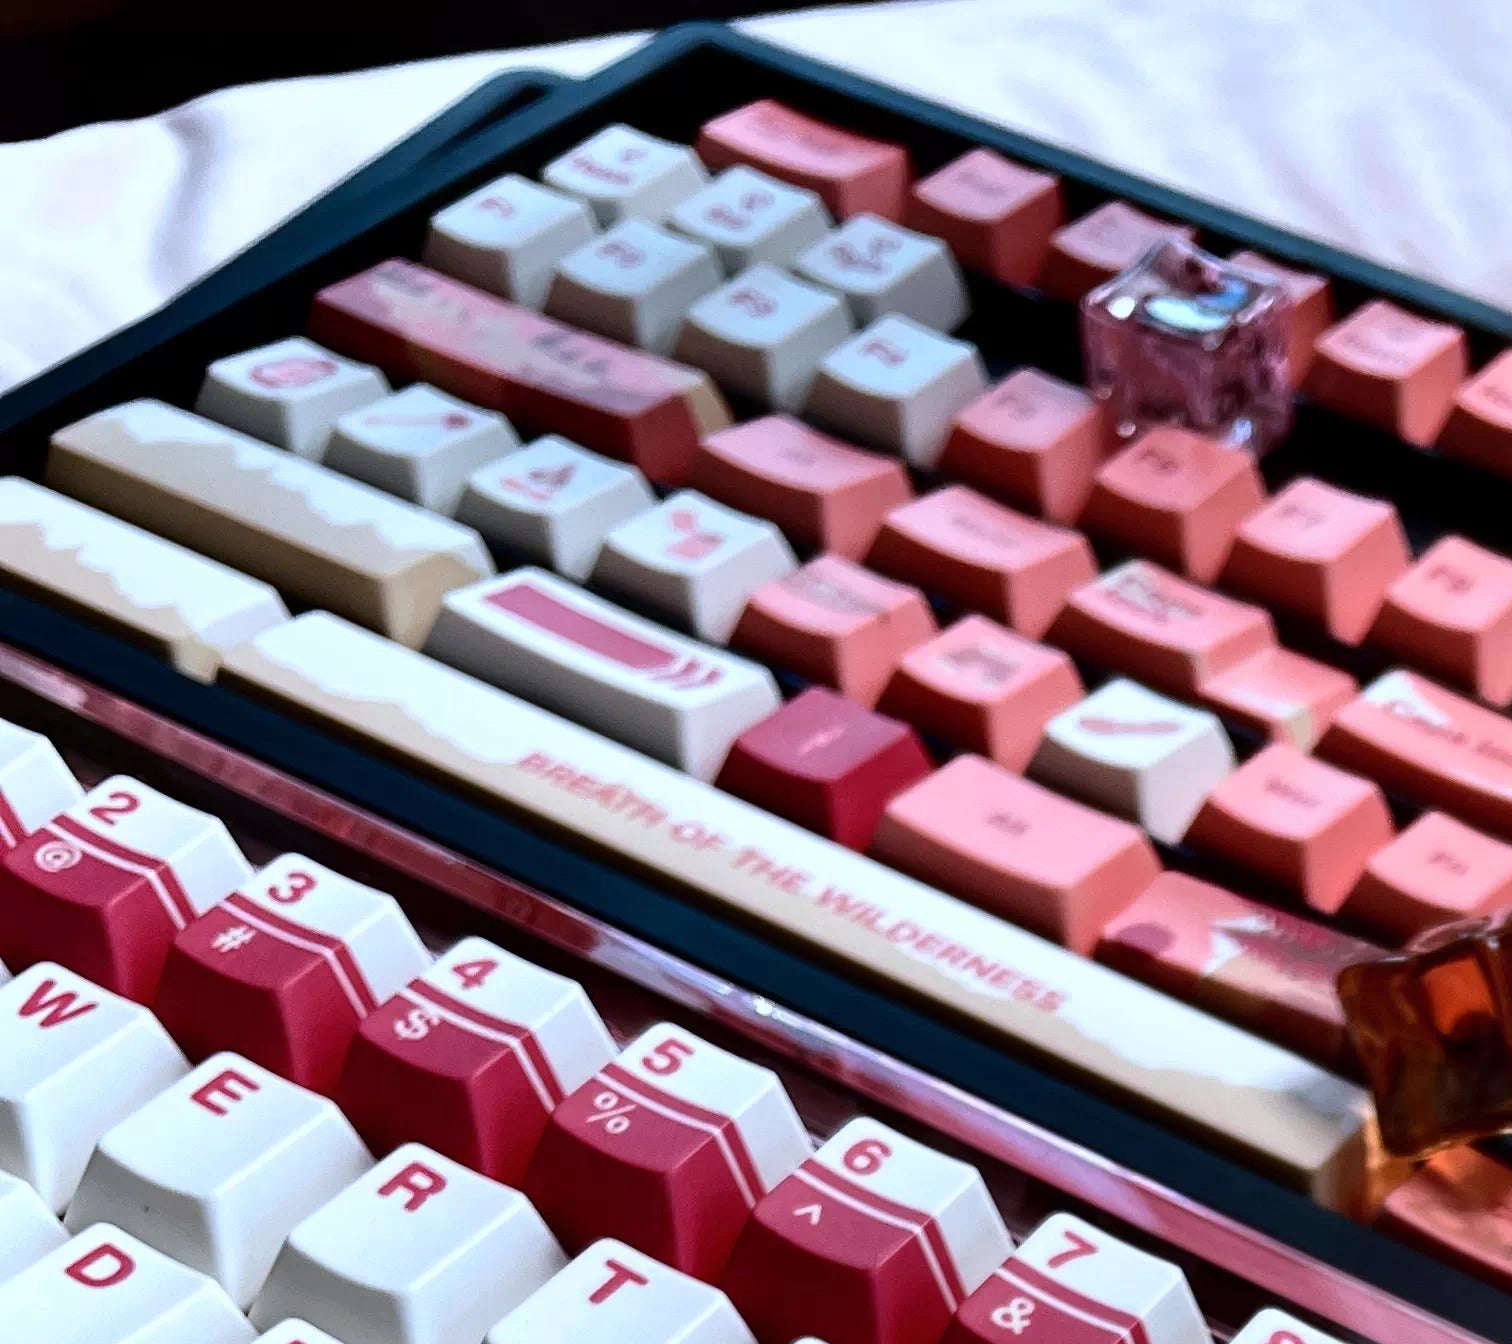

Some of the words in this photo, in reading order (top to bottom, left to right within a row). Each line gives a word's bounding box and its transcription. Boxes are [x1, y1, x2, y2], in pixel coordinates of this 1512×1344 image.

[90, 792, 140, 826] 2
[34, 841, 82, 872] @
[267, 872, 317, 904] 3
[517, 752, 668, 827] BREATH
[669, 822, 724, 851] OF
[731, 848, 813, 894] THE
[816, 886, 1065, 1013] WILDERNESS
[212, 926, 257, 952] #
[451, 958, 498, 990] 4
[18, 978, 98, 1028] W
[395, 1005, 441, 1040] $
[642, 1037, 694, 1075] 5
[189, 1068, 260, 1115] E
[593, 1089, 630, 1135] %
[843, 1139, 891, 1174] 6
[378, 1162, 448, 1211] R
[66, 1244, 134, 1288] D
[1048, 1231, 1097, 1268] 7
[589, 1259, 655, 1304] T
[991, 1298, 1036, 1335] &
